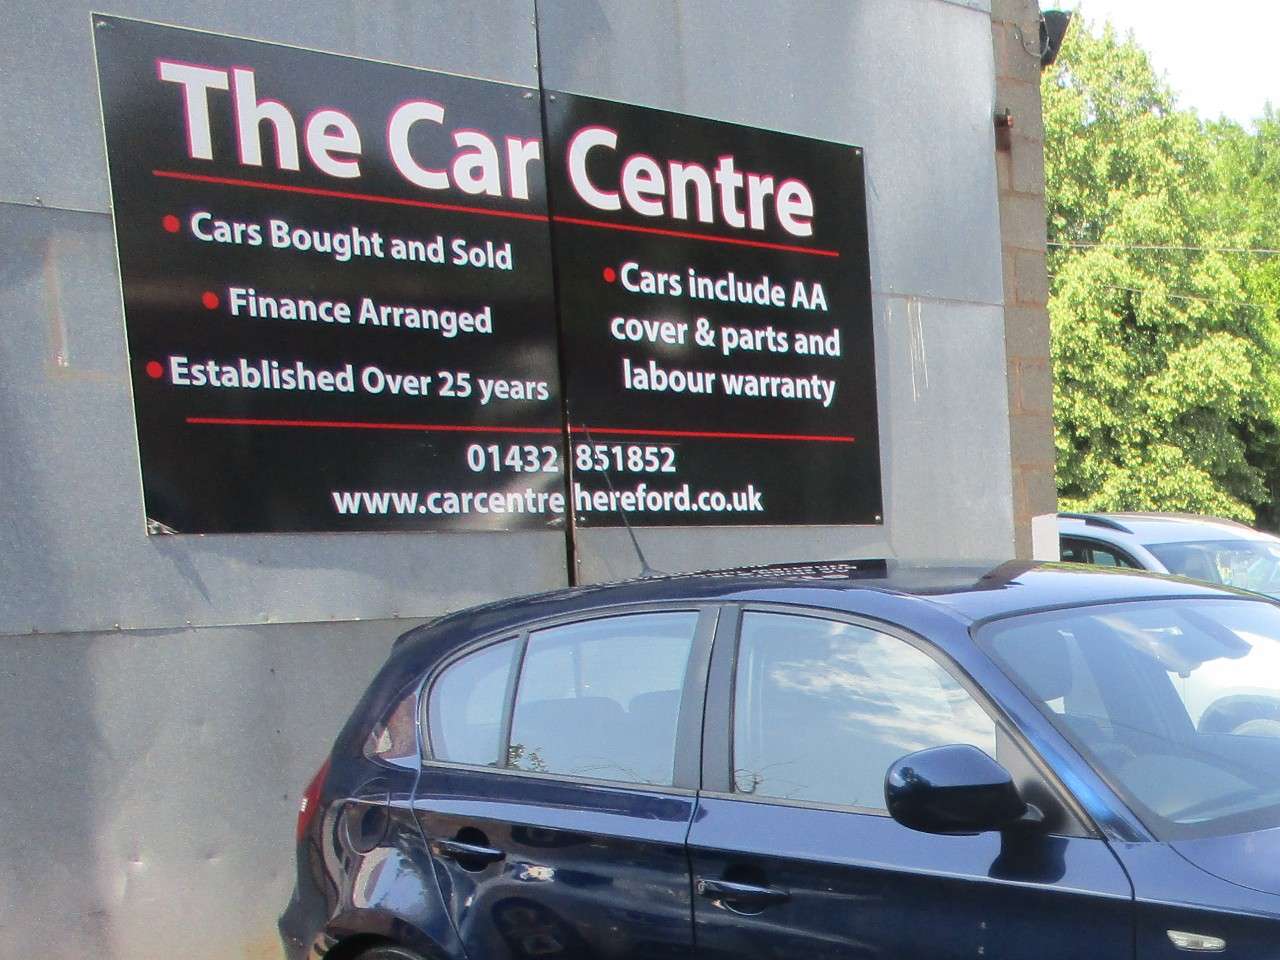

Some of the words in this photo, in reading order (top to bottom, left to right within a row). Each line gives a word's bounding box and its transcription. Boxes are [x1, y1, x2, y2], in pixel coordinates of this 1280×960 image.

[158, 60, 362, 180] The
[387, 99, 541, 202] Car
[567, 127, 814, 238] Centre
[190, 211, 263, 246] Cars
[269, 218, 385, 262] Bought
[390, 235, 445, 264] and
[451, 238, 513, 270] Sold
[620, 262, 683, 297] Cars
[687, 266, 786, 307] include
[791, 280, 828, 311] AA
[229, 287, 351, 324] Finance
[358, 297, 493, 338] Arranged
[610, 317, 689, 345] cover
[694, 317, 716, 347] &
[721, 325, 789, 356] parts
[794, 328, 841, 357] and
[170, 356, 355, 392] Established
[361, 366, 432, 397] Over
[438, 371, 472, 398] 25
[477, 377, 549, 406] years
[623, 358, 716, 393] labour
[720, 370, 836, 408] warranty
[467, 443, 559, 473] 01432
[575, 443, 676, 473] 851852
[332, 482, 764, 515] www.carcentrehereford.co.uk
